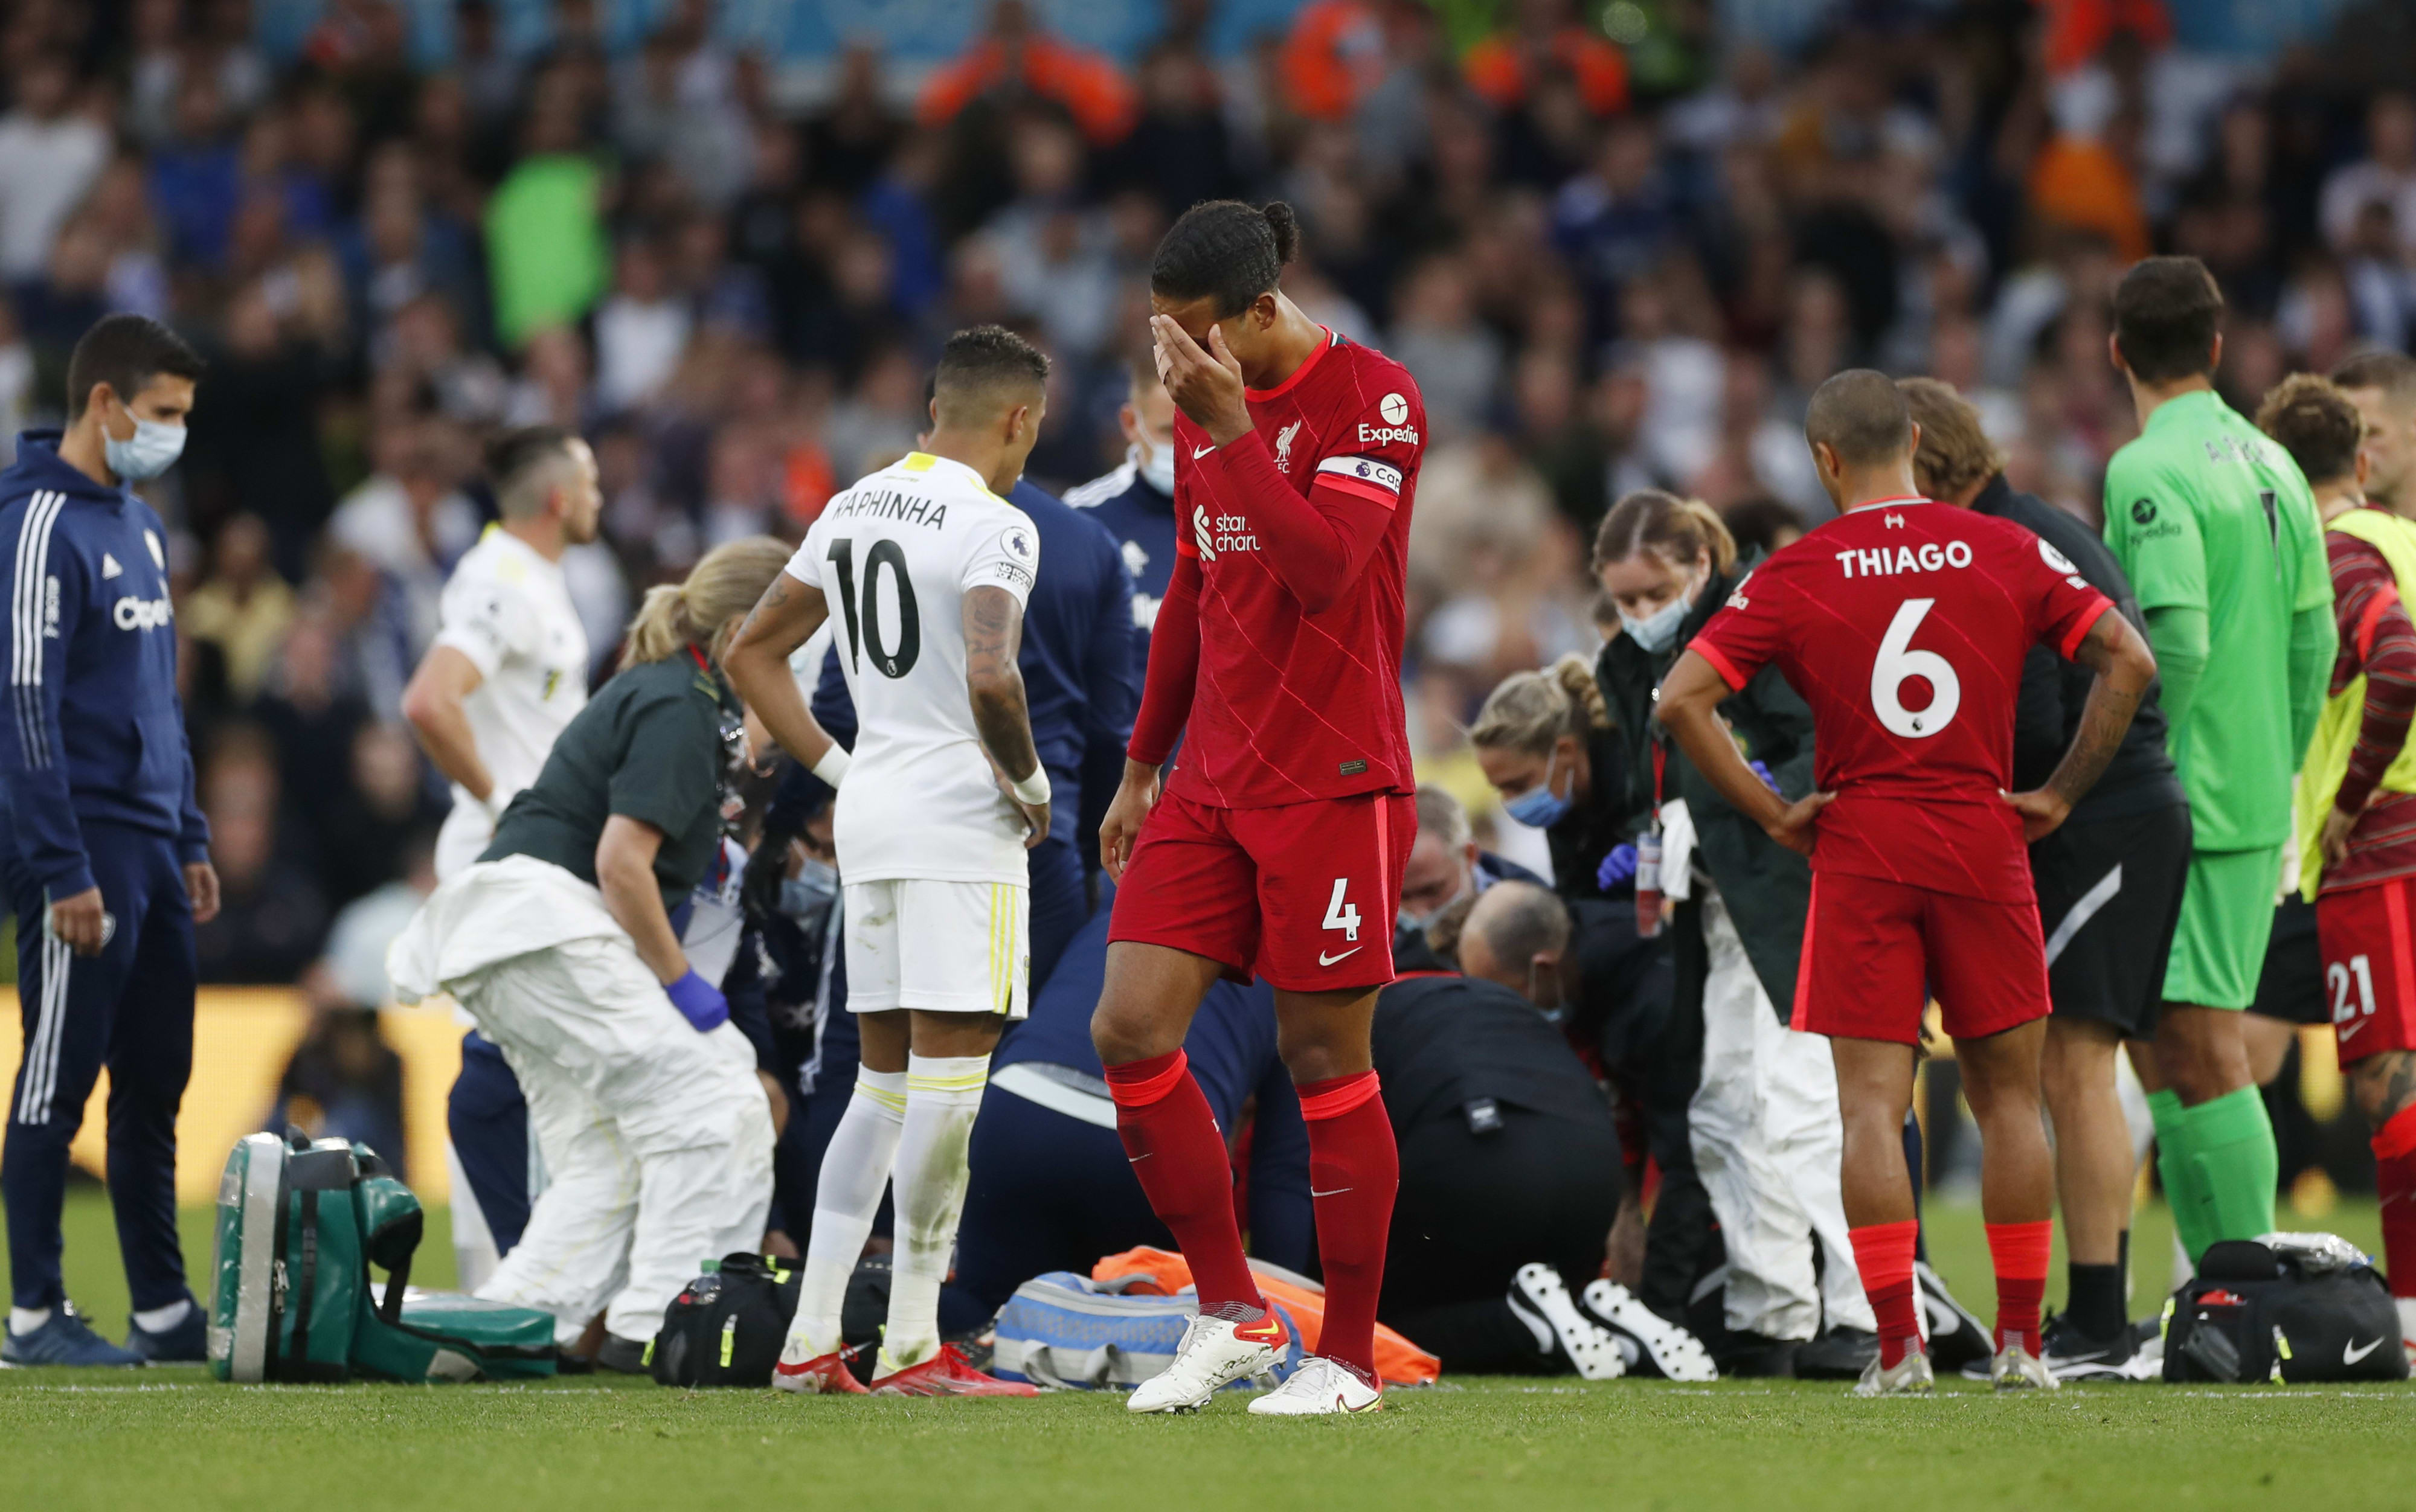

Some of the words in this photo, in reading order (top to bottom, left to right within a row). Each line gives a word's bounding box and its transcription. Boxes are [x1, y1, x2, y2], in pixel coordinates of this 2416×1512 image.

[1358, 423, 1419, 447] Expedia
[832, 490, 947, 530] RAPHINHA
[996, 562, 1012, 573] No
[1835, 540, 1973, 578] THIAGO
[827, 539, 920, 679] 10
[1871, 597, 1961, 738] 6
[1322, 877, 1362, 941] 4
[2327, 953, 2376, 1025] 21
